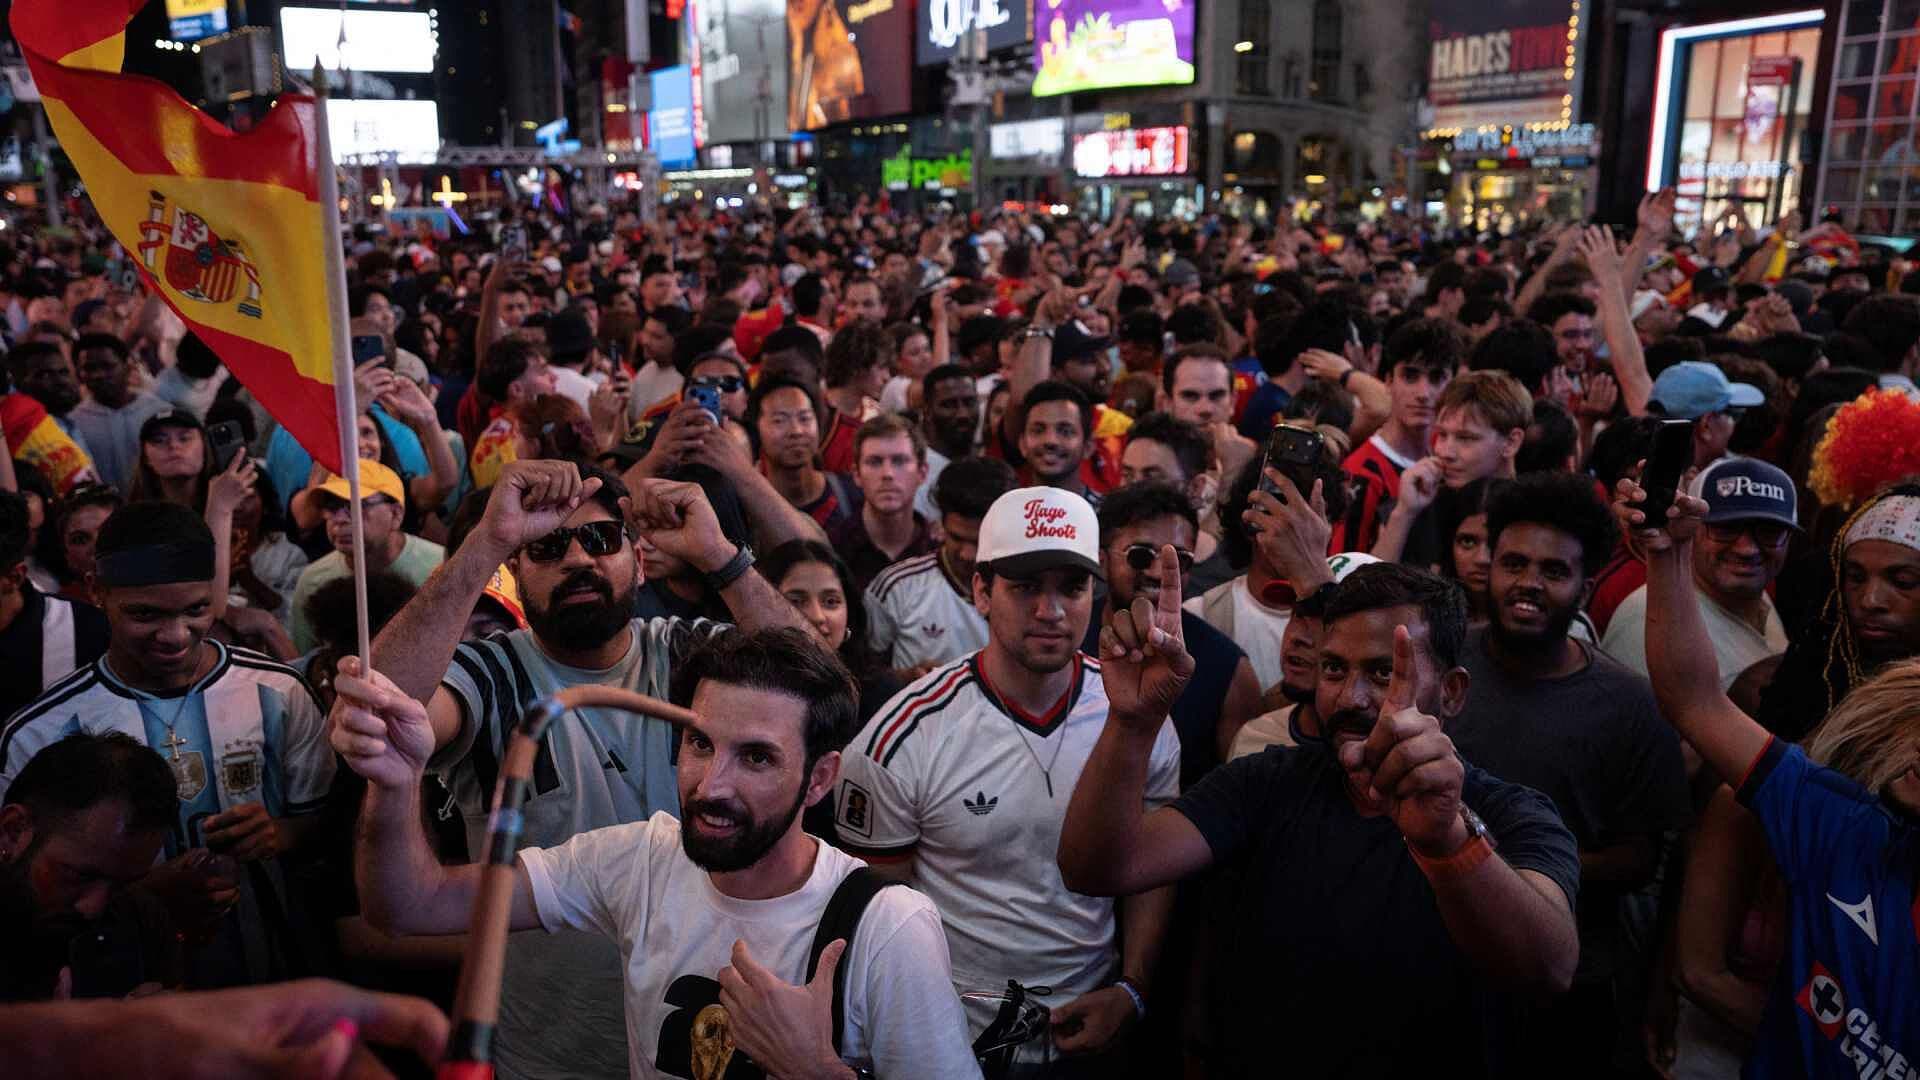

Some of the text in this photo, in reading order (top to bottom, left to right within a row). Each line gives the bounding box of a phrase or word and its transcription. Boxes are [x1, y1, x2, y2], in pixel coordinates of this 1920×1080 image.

[1734, 476, 1785, 502] Penn
[1024, 499, 1067, 523] Tiago
[1025, 518, 1077, 540] Shoots
